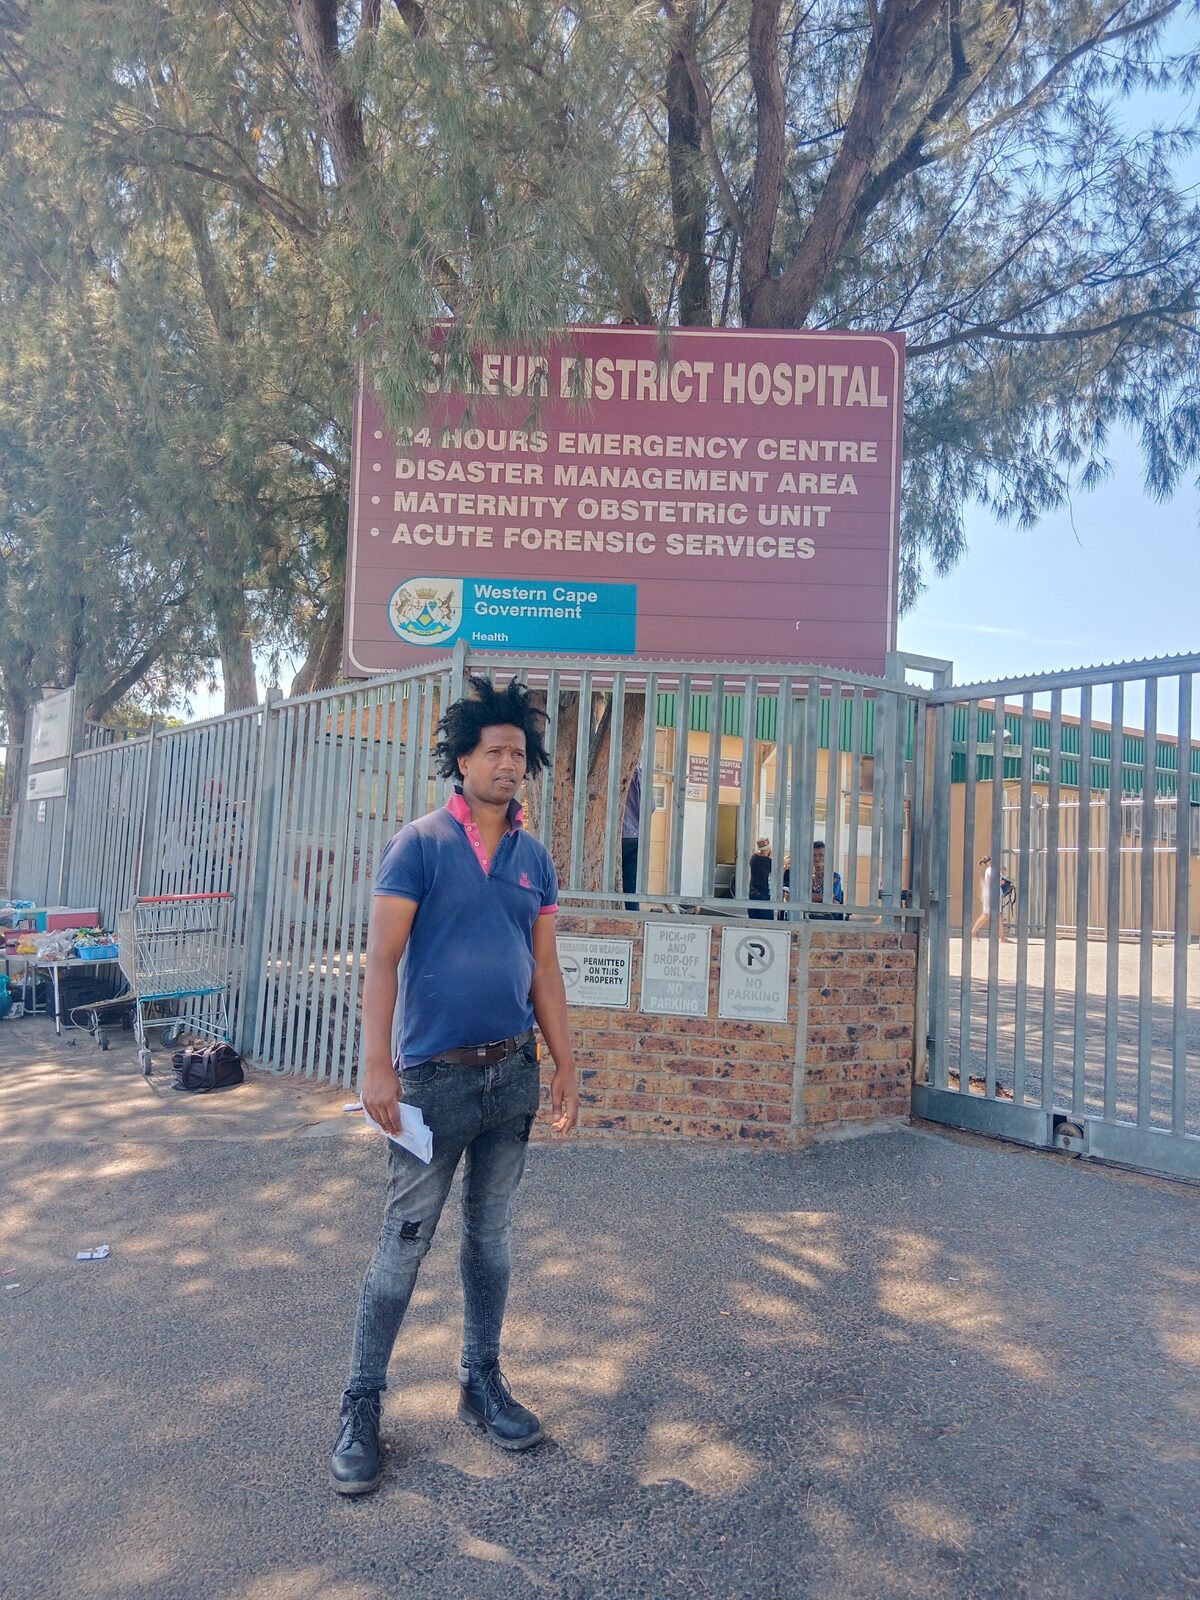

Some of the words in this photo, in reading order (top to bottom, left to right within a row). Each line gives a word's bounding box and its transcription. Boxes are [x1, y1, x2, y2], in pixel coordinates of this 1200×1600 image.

[560, 356, 714, 403] DISTRICT
[723, 361, 888, 408] HOSPITAL
[396, 426, 431, 448] 24
[441, 427, 548, 453] HOURS
[558, 431, 748, 460] EMERGENCY
[756, 438, 878, 463] CENTRE
[395, 458, 544, 485] DISASTER
[554, 464, 769, 493] MANAGEMENT
[777, 471, 858, 495] AREA
[393, 490, 568, 519] MATERNITY
[577, 498, 748, 524] OBSTETRIC
[757, 503, 832, 527] UNIT
[391, 522, 494, 548] ACUTE
[503, 527, 656, 554] FORENSIC
[665, 532, 816, 559] SERVICES
[474, 584, 547, 602] Western
[552, 587, 598, 606] Cape
[474, 601, 582, 620] Government
[472, 631, 509, 643] Health
[660, 930, 697, 943] PICK-UP
[667, 943, 687, 954] AND
[583, 957, 625, 967] PERMITTED
[653, 953, 699, 967] DROP-OFF
[589, 966, 600, 975] ON
[602, 967, 619, 976] THIS
[664, 965, 688, 977] ONLY
[584, 975, 623, 985] PROPERTY
[745, 977, 762, 989] NO
[667, 982, 683, 995] NO
[727, 988, 780, 1002] PARKING
[650, 996, 698, 1011] PARKING
